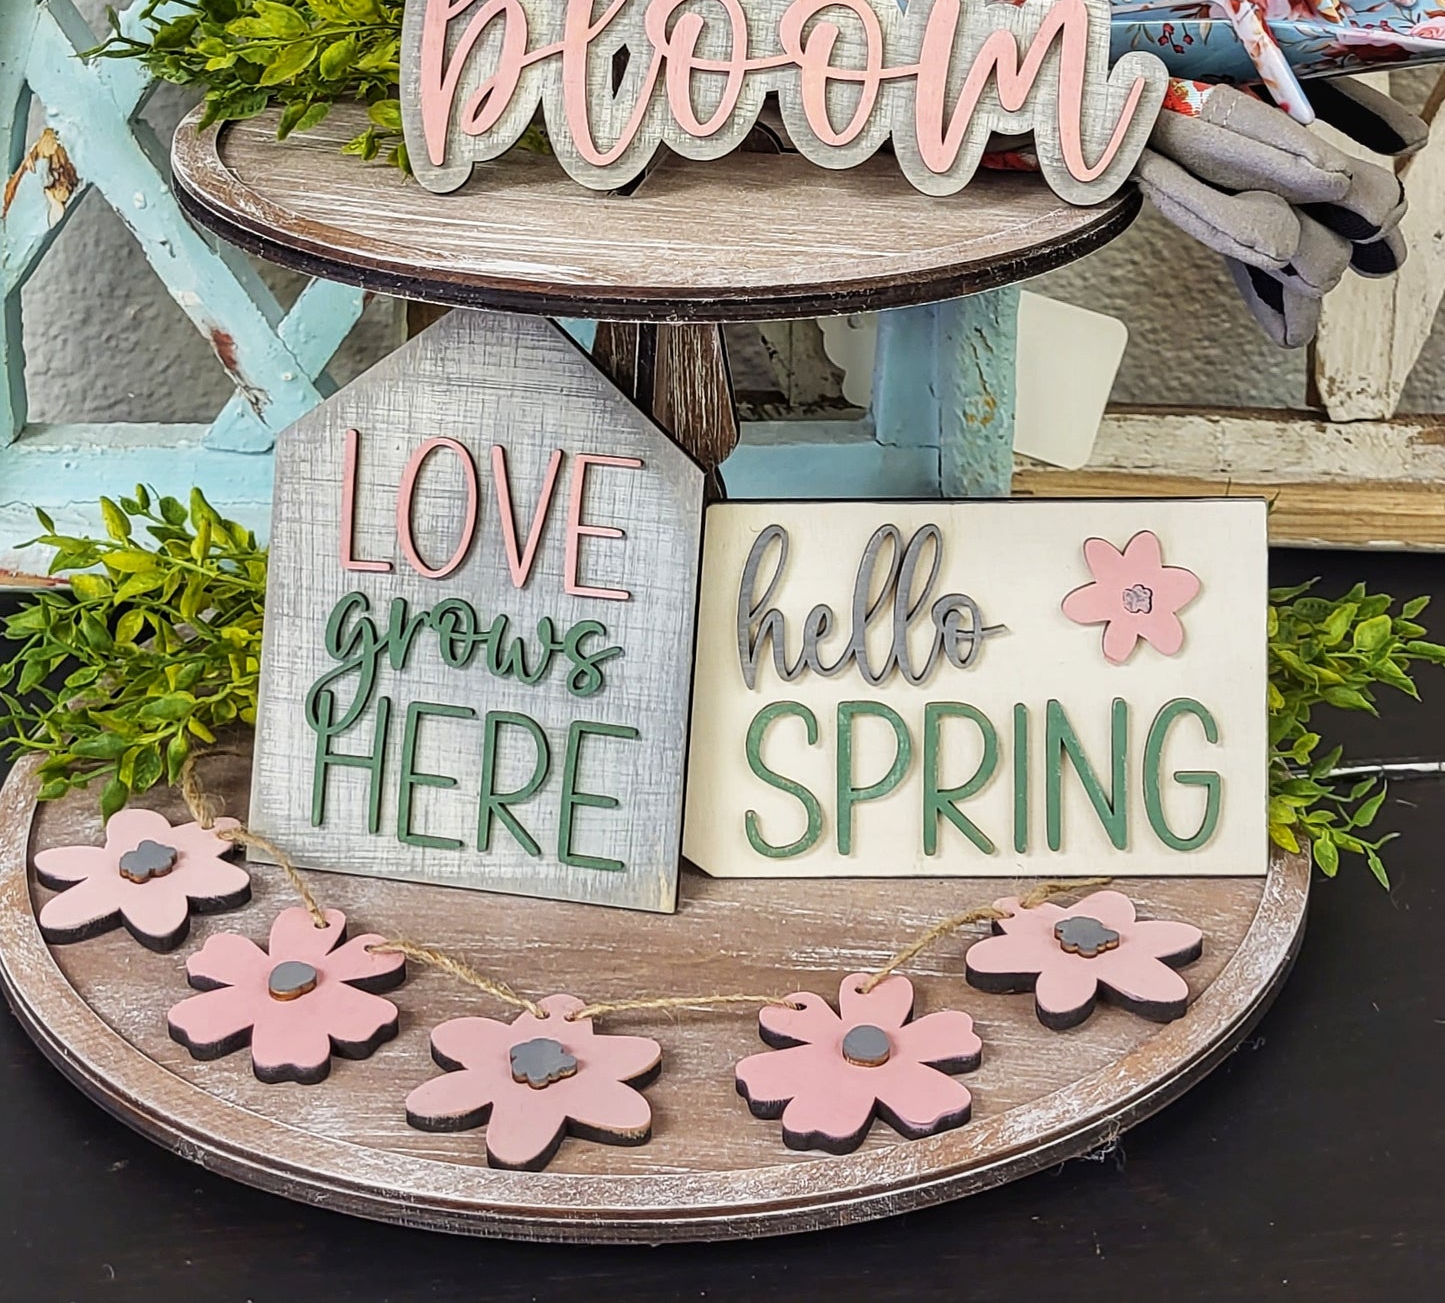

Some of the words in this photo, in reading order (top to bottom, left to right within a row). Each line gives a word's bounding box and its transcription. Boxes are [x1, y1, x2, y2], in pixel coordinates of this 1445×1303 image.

[340, 428, 644, 599] LOVE
[305, 591, 624, 735] grows
[737, 523, 1009, 691] hello
[311, 690, 640, 871] HERE
[744, 697, 1221, 858] SPRING
